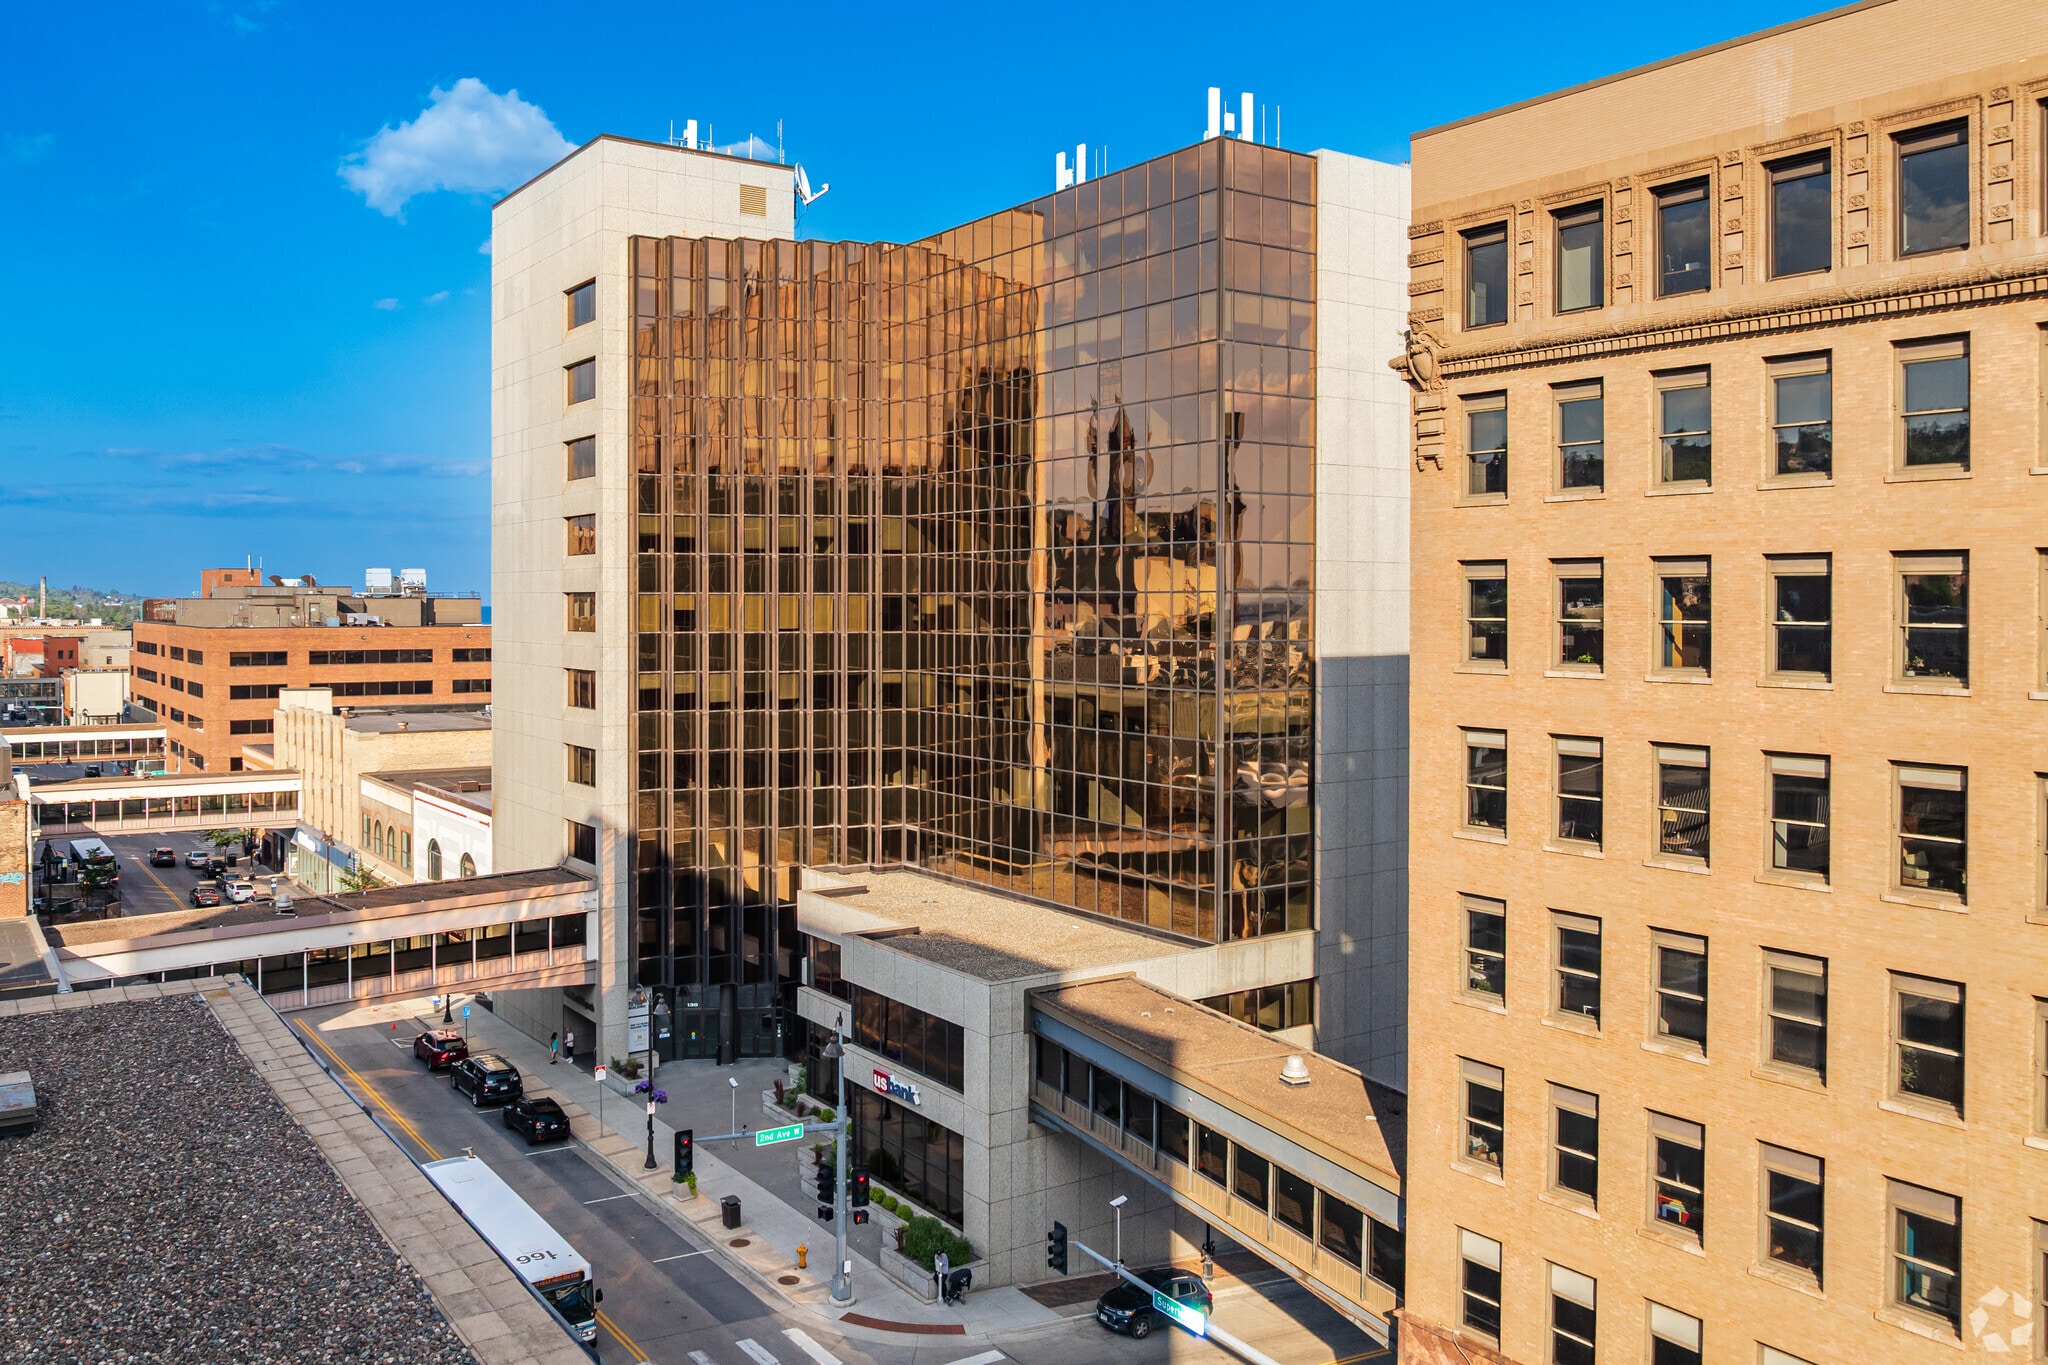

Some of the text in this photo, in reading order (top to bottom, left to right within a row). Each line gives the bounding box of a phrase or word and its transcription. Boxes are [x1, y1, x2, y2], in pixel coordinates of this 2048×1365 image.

[759, 1127, 801, 1142] 2nd Ave W
[516, 1250, 558, 1264] 166
